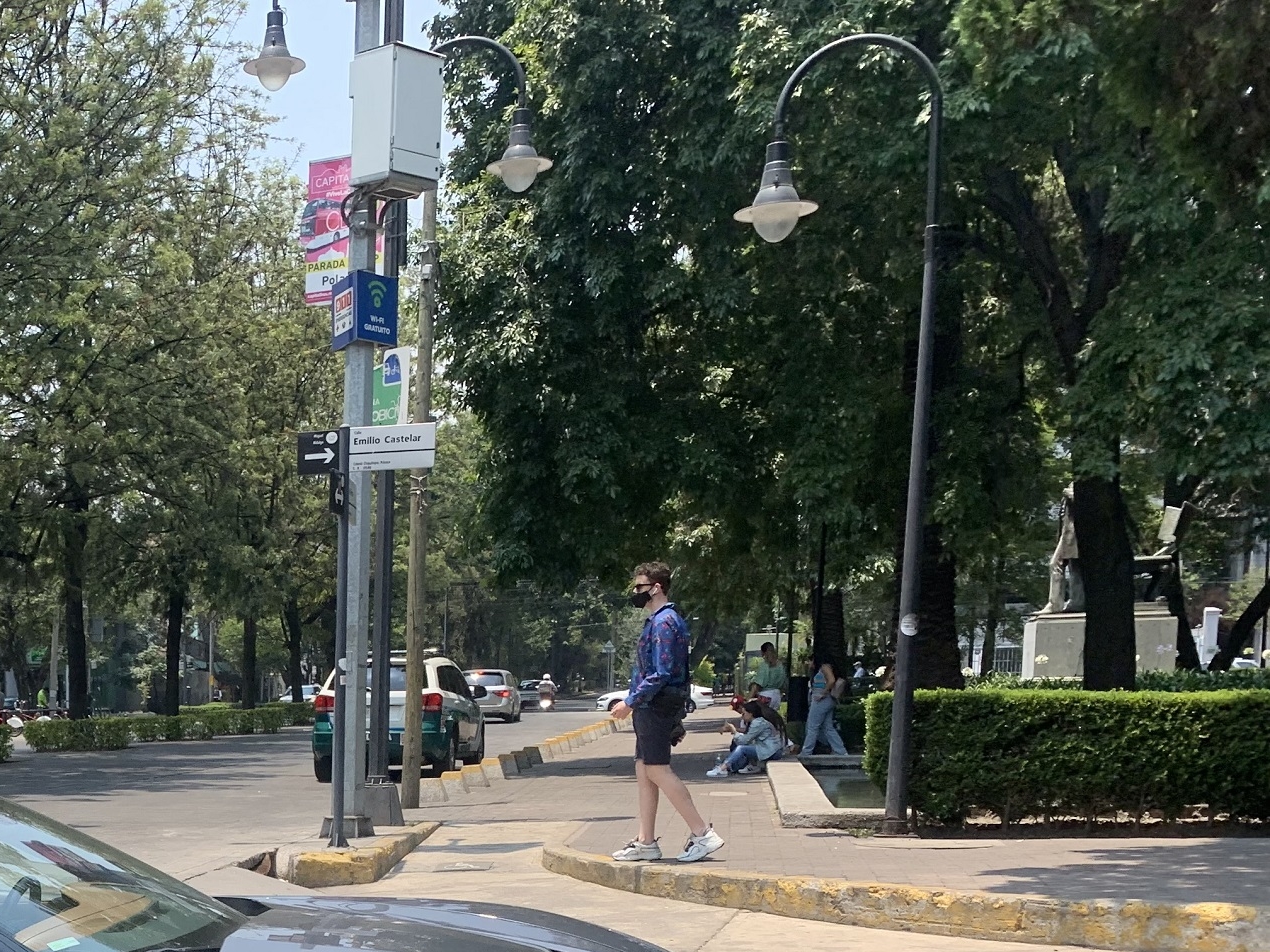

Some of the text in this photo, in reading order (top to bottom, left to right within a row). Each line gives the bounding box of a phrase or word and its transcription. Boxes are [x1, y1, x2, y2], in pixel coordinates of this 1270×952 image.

[308, 260, 346, 272] PARADA
[364, 323, 390, 335] GRATUITO
[353, 434, 421, 446] Emilio Castelar
